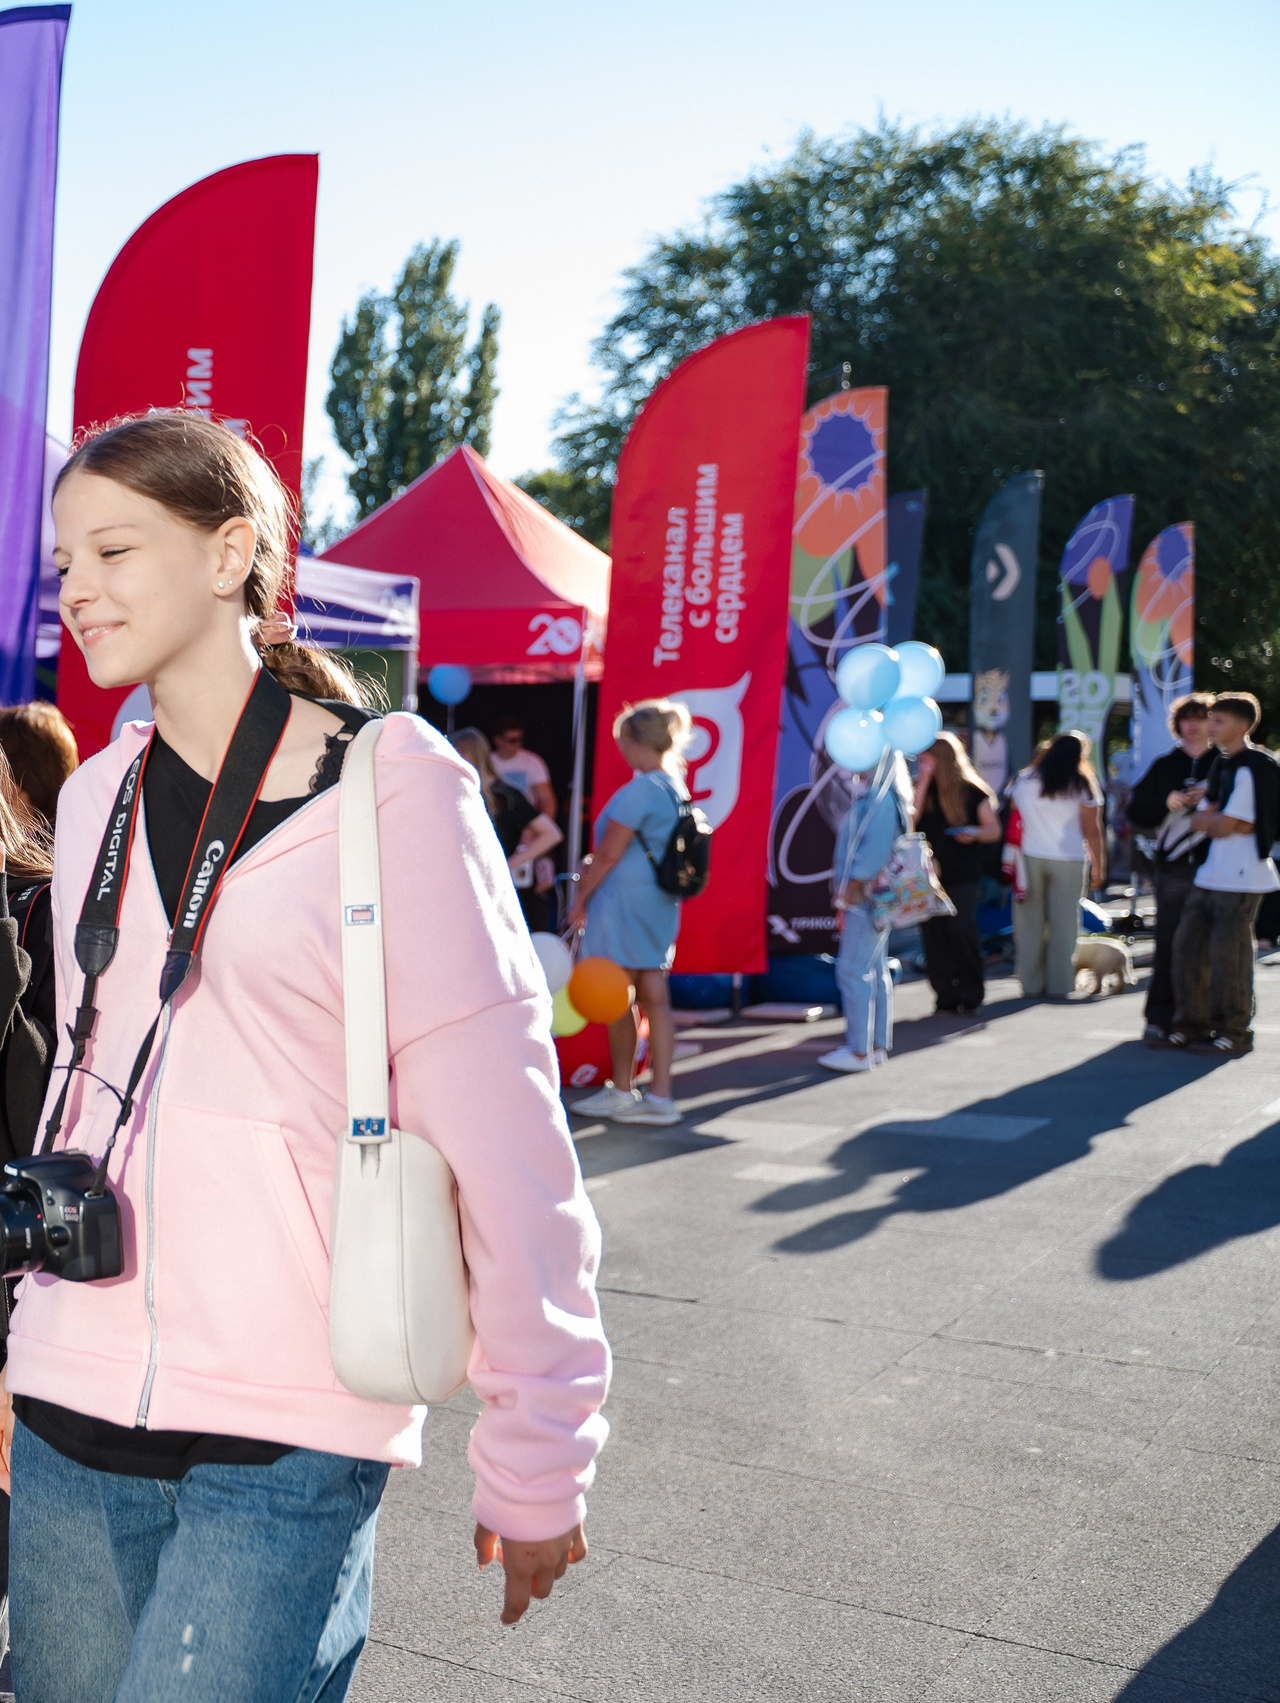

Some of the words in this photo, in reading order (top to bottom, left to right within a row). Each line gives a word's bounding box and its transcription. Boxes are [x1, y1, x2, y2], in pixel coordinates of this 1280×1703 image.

[685, 463, 719, 606] большим
[715, 512, 747, 643] сердцем
[653, 507, 688, 667] Телеканал
[689, 609, 711, 628] с
[525, 613, 582, 656] 20
[123, 758, 141, 805] EOS
[96, 812, 127, 901] DIGITAL
[183, 839, 225, 929] Canon
[789, 916, 837, 930] ТРИКО
